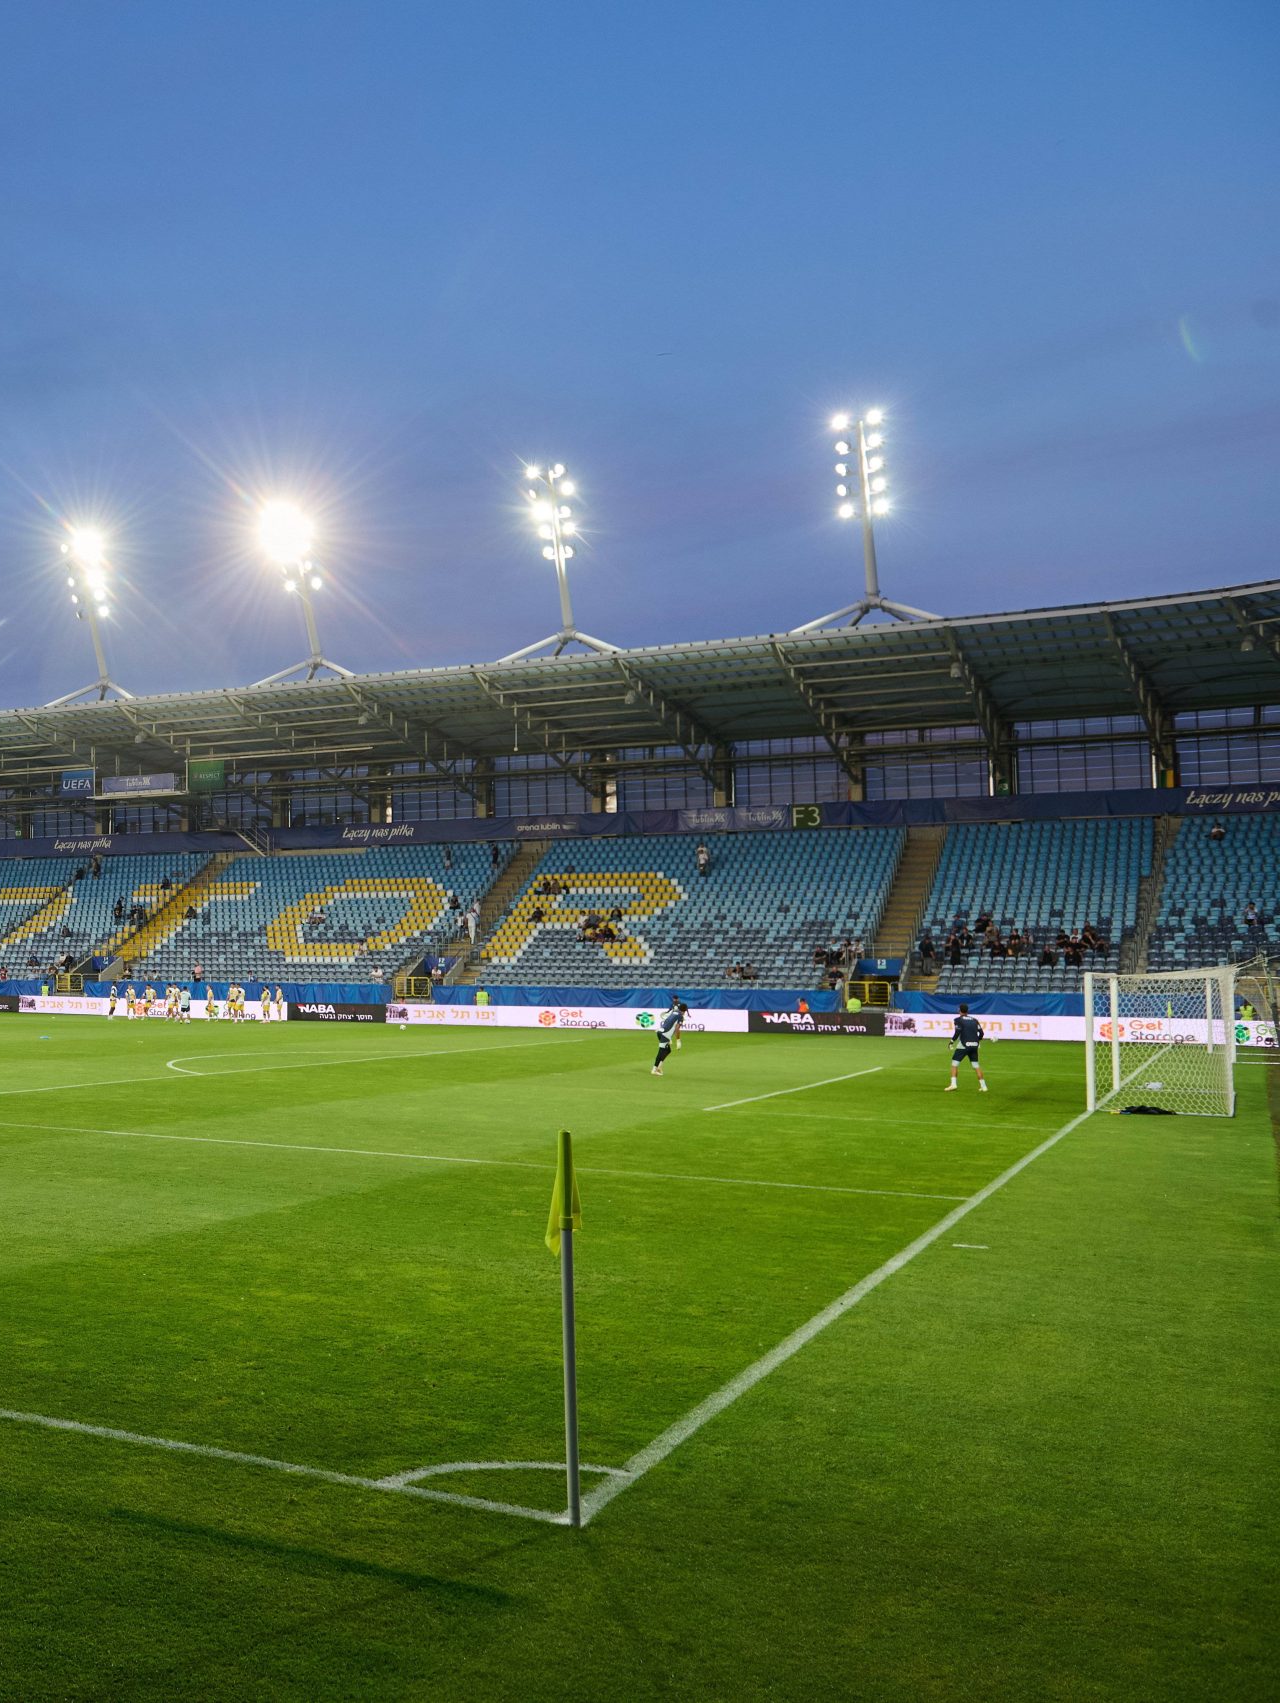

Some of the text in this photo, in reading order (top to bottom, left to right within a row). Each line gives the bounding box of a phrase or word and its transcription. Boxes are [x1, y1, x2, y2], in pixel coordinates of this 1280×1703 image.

[62, 779, 91, 789] UEFA
[1186, 790, 1233, 809] Łączy
[1235, 792, 1265, 804] nas
[792, 806, 820, 827] F3
[372, 828, 389, 838] nas
[77, 841, 91, 849] nas
[297, 1004, 335, 1013] NABA
[559, 1008, 583, 1018] Get
[760, 1012, 815, 1024] NABA
[560, 1019, 606, 1029] Storage
[817, 1024, 841, 1032] יצחק
[923, 1019, 953, 1030] ביב
[1129, 1019, 1163, 1030] Get
[1130, 1031, 1195, 1044] Storage
